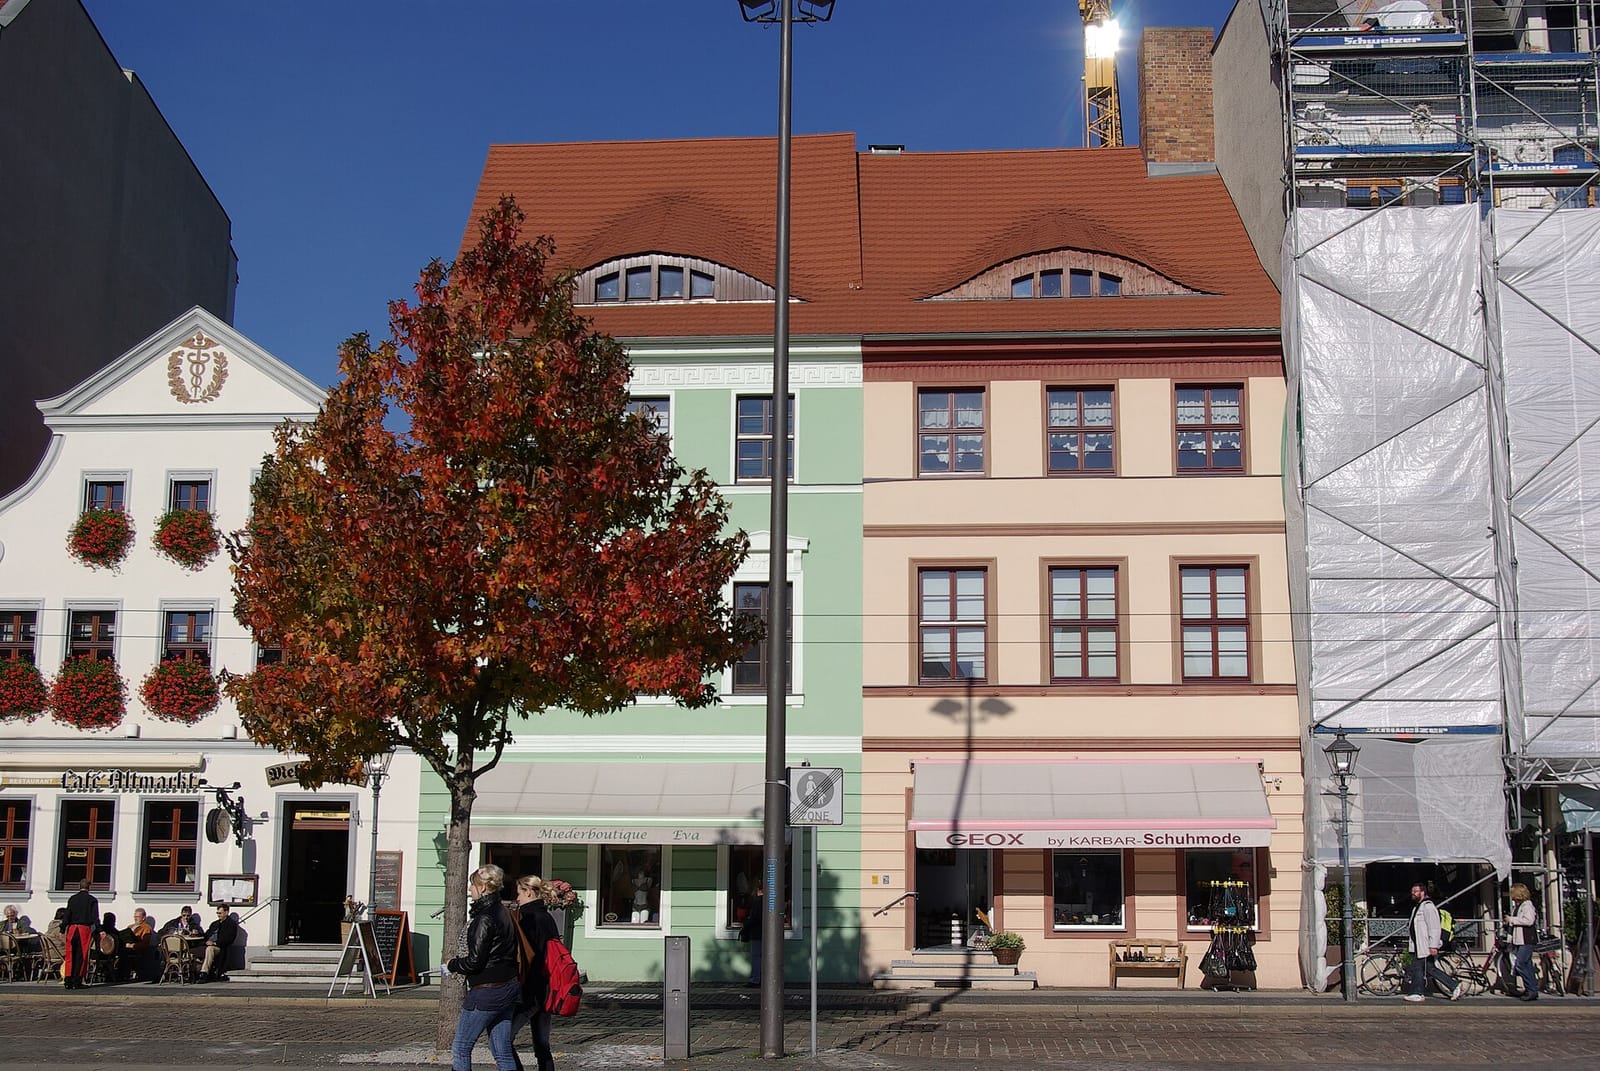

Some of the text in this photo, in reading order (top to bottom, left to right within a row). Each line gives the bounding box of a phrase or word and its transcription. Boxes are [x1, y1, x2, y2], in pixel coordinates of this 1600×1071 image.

[1343, 36, 1422, 46] Schweizer
[61, 769, 200, 789] Café Altmarkt
[537, 828, 700, 843] Miederboutique Eva
[946, 833, 1025, 846] GEOX
[1047, 836, 1065, 847] by
